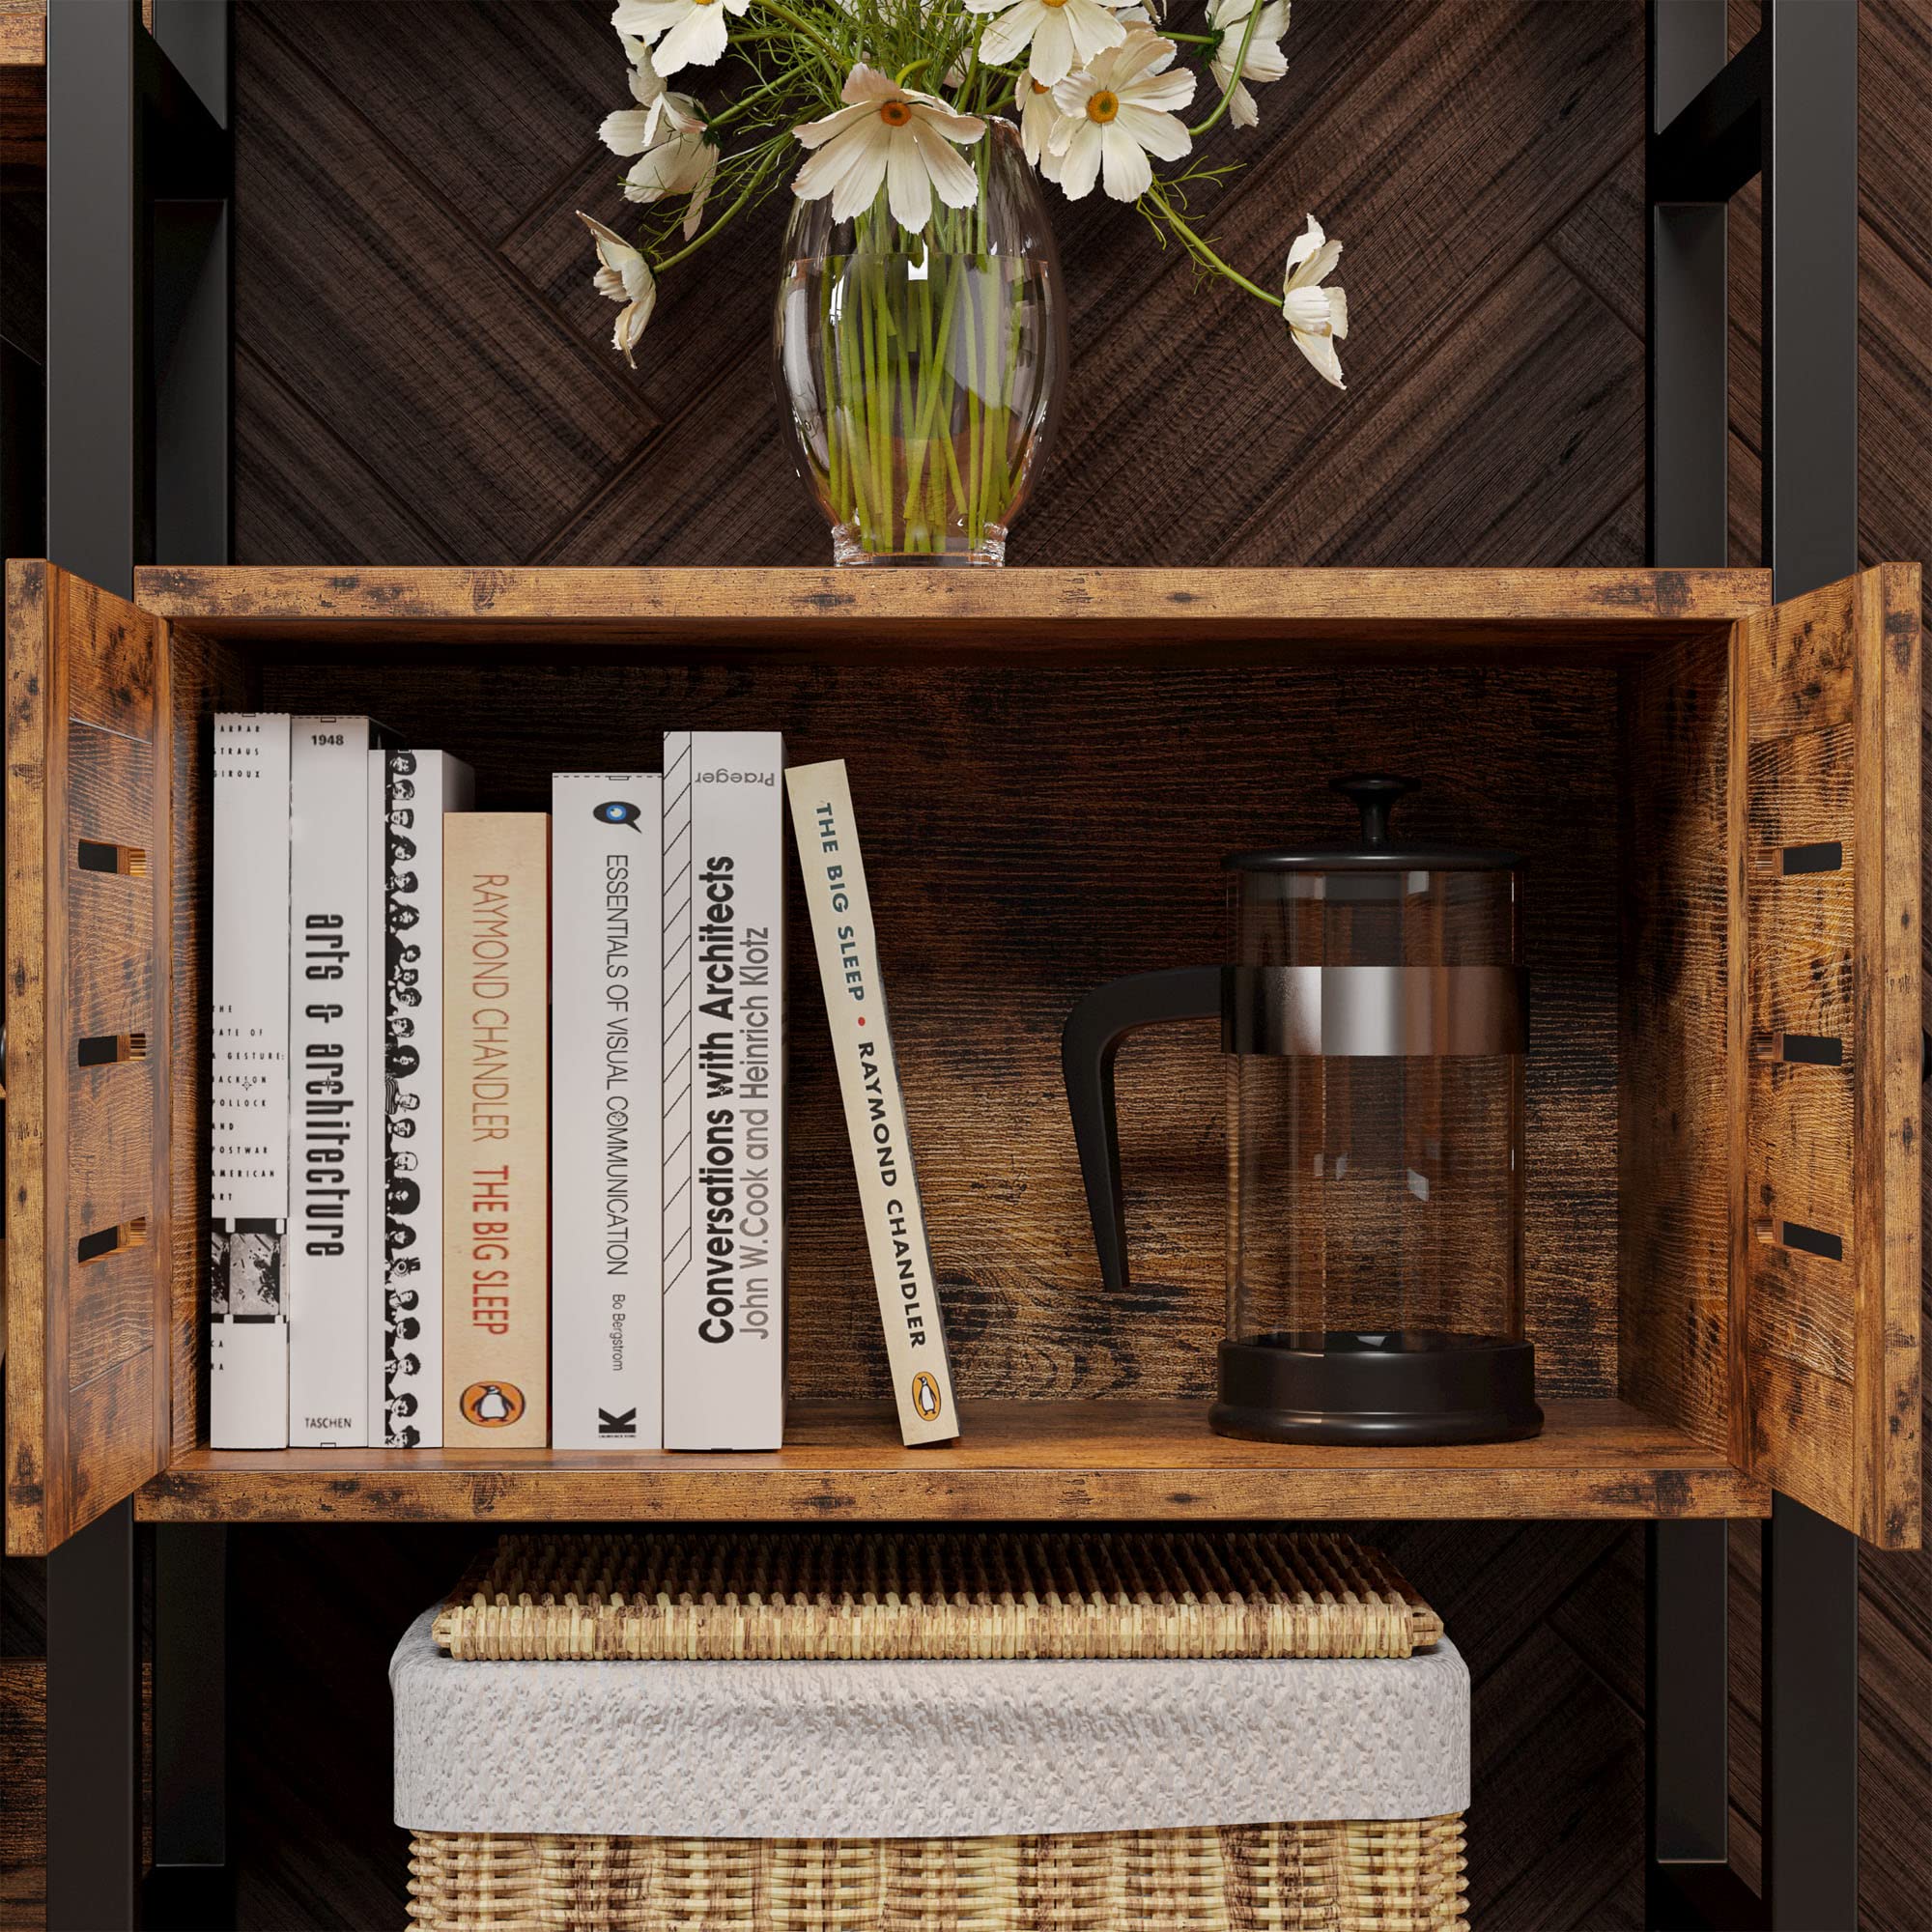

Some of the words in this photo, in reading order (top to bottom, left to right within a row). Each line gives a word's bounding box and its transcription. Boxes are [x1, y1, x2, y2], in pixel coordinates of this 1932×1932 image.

[311, 733, 345, 747] 1948
[694, 768, 775, 787] Praeger
[815, 802, 839, 854] THE
[606, 854, 629, 979] ESSENTIALS
[826, 865, 849, 913] BIG
[305, 914, 351, 980] arts
[471, 874, 510, 1000] RAYMOND
[697, 855, 735, 1022] Architects
[738, 926, 770, 986] Klotz
[837, 924, 866, 1002] SLEEP
[606, 983, 629, 1012] OF
[250, 1028, 263, 1037] OF
[606, 1017, 629, 1091] VISUAL
[738, 994, 769, 1099] Heinrich
[471, 1008, 510, 1143] CHANDLER
[697, 1032, 735, 1099] with
[305, 1043, 355, 1257] architecture
[738, 1108, 769, 1161] and
[471, 1164, 510, 1213] THE
[606, 1095, 629, 1275] COMMUNICATION
[858, 1041, 896, 1188] RAYMOND
[886, 1198, 926, 1350] CHANDLER
[471, 1222, 510, 1261] BIG
[697, 1109, 735, 1345] Conversations
[471, 1269, 510, 1335] SLEEP
[611, 1293, 626, 1310] Bo
[738, 1277, 770, 1340] John
[609, 1313, 626, 1372] Bergstrom
[304, 1417, 352, 1430] TASCHEN
[598, 1406, 637, 1434] K
